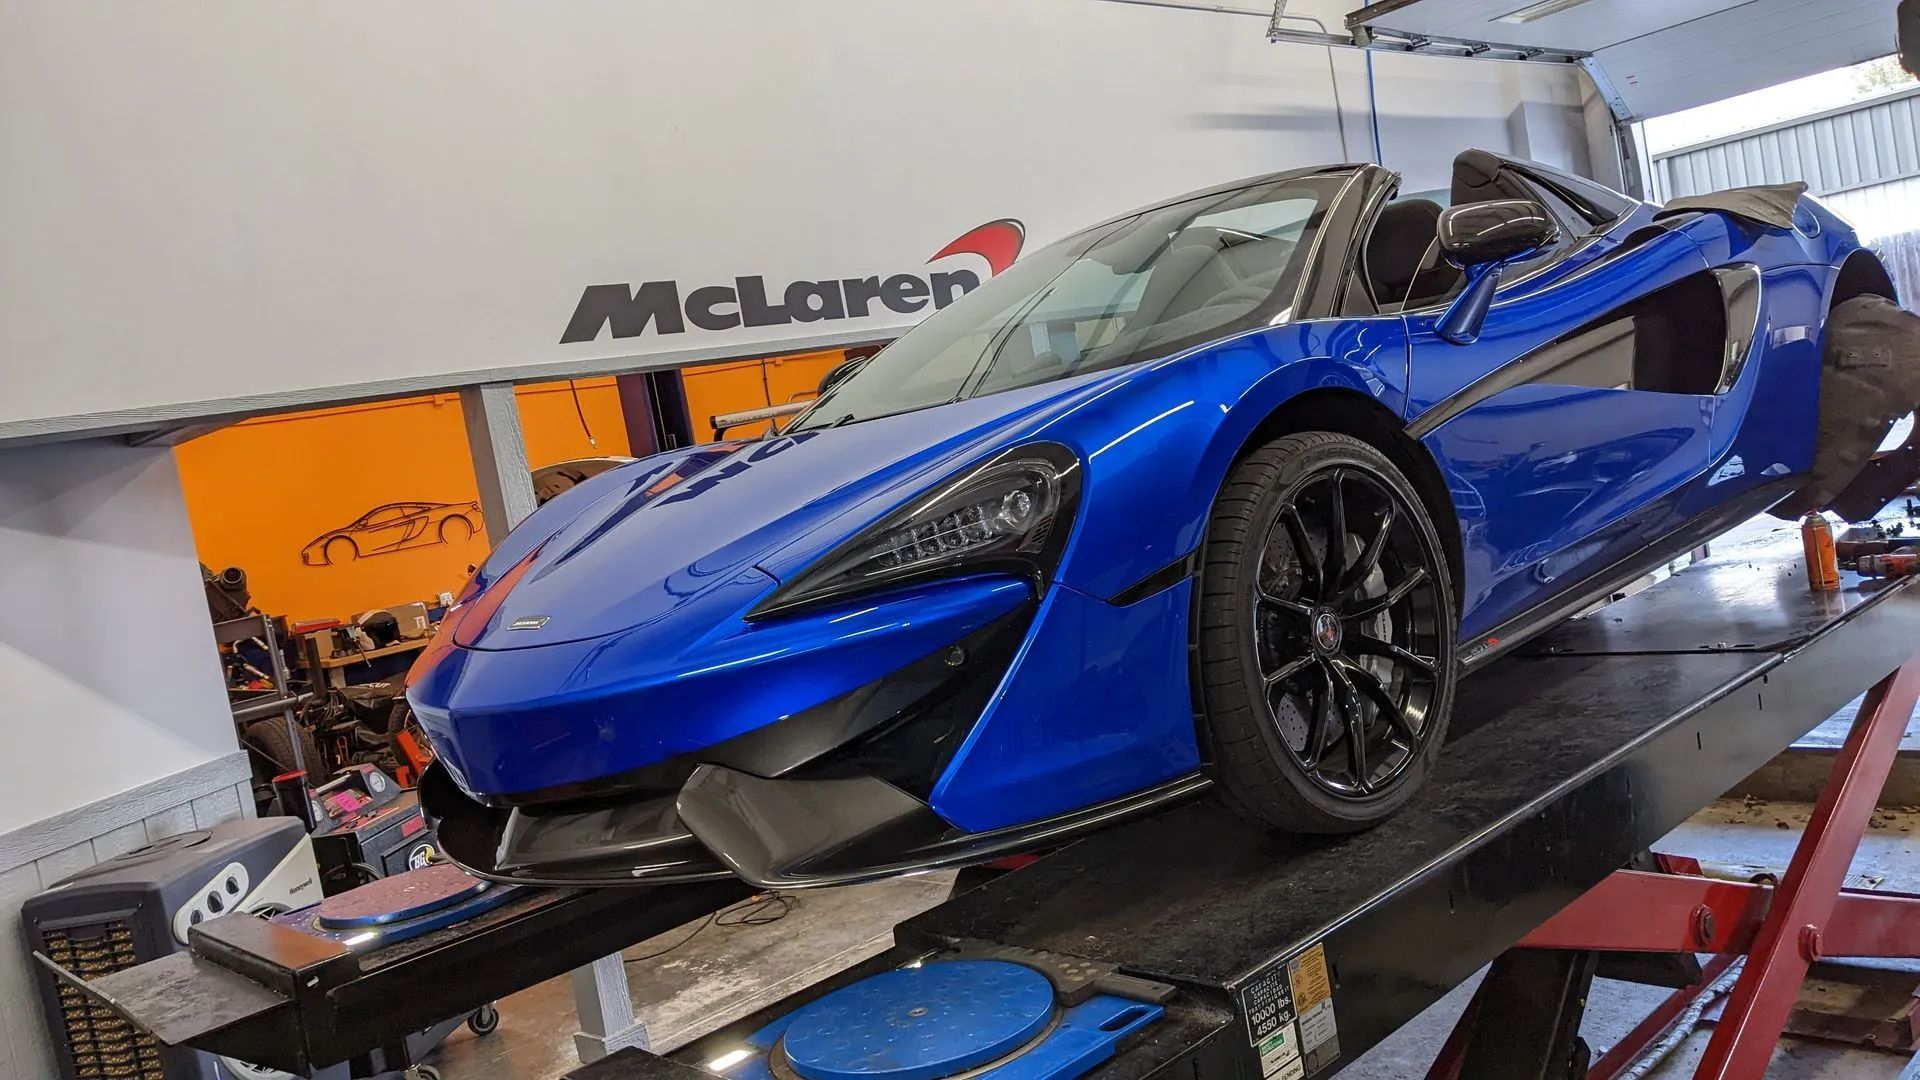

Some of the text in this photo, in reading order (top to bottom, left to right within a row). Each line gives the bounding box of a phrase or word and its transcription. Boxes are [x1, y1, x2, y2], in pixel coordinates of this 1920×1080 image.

[558, 269, 980, 344] McLaren
[289, 877, 313, 896] Honeywell
[1252, 996, 1291, 1025] 10000 lbs.
[1257, 1010, 1291, 1036] 4550 kg.
